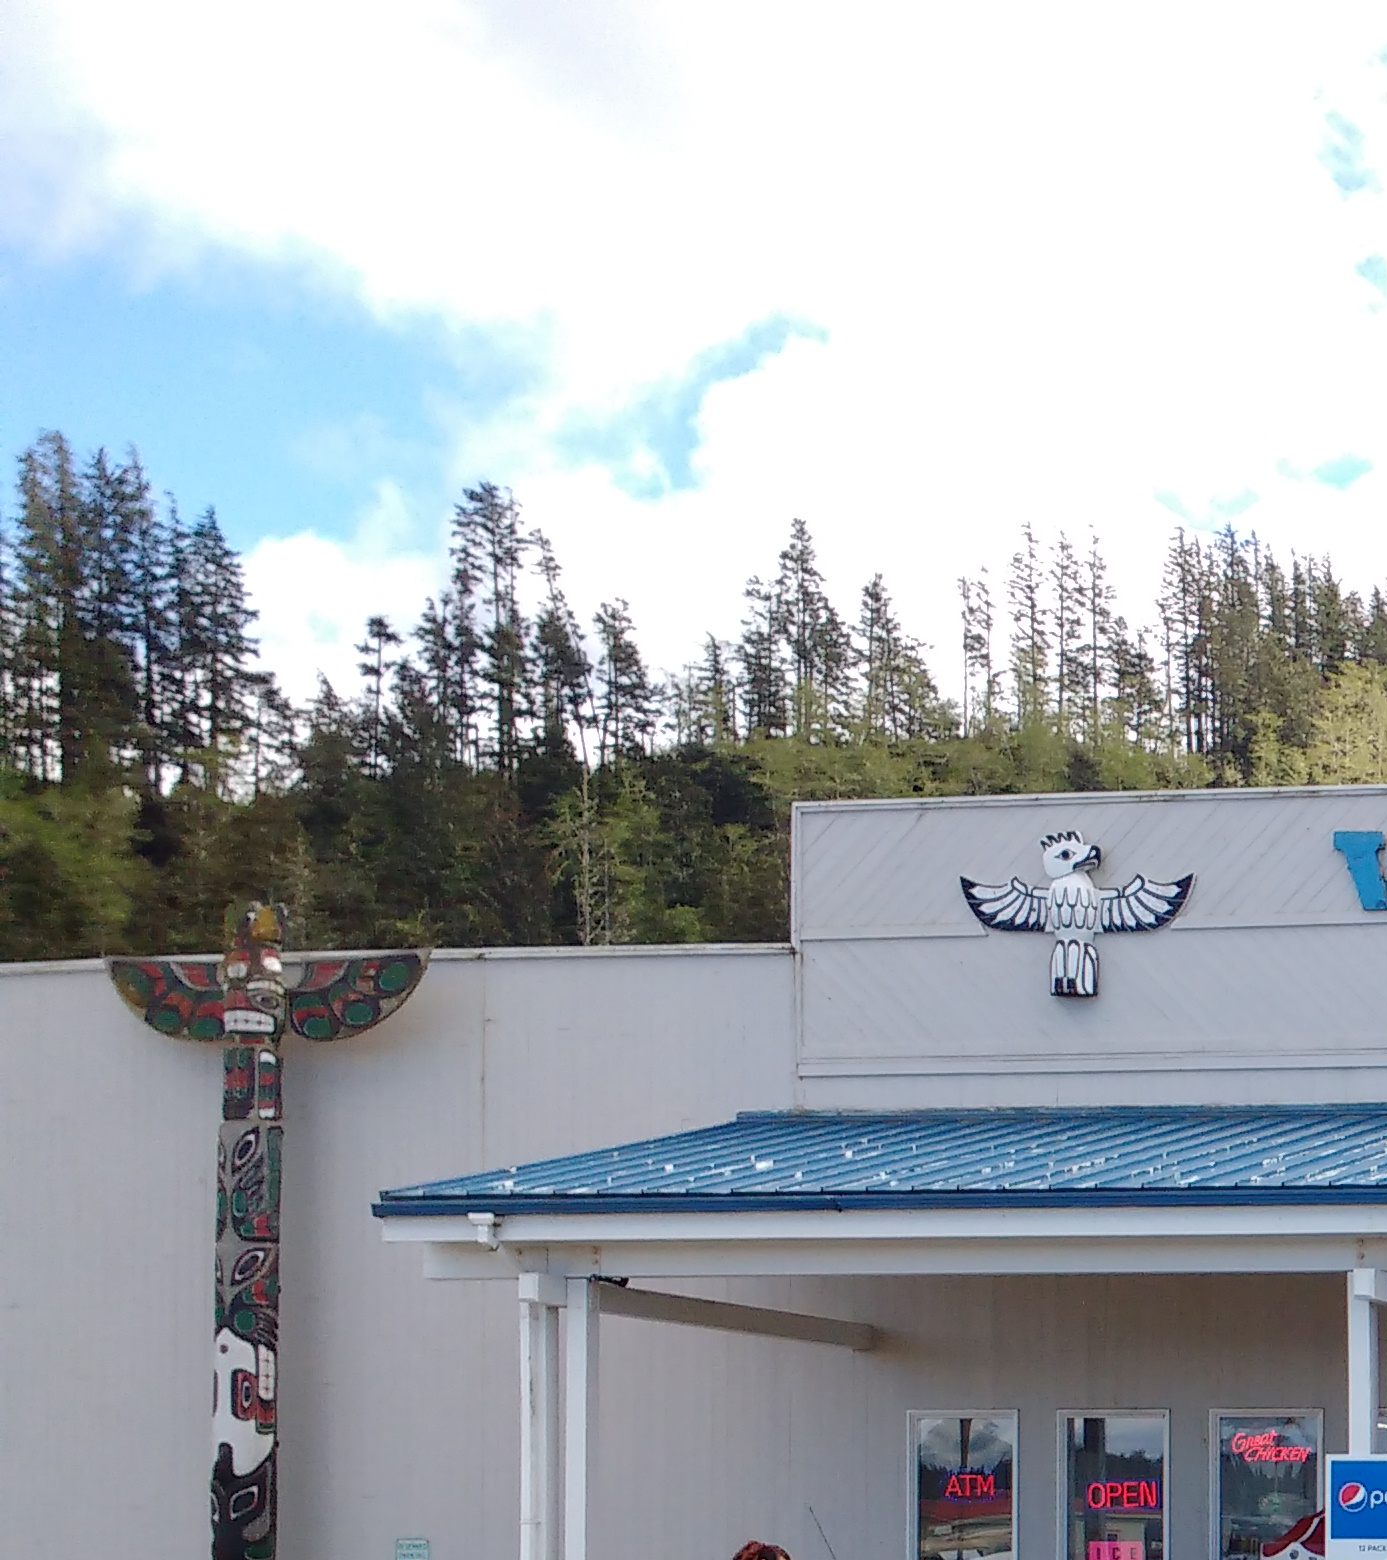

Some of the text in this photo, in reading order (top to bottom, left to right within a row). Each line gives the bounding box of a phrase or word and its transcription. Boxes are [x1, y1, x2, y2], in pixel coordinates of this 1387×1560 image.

[1244, 1447, 1312, 1463] CHICKEN
[945, 1474, 996, 1497] ATM
[1088, 1481, 1158, 1510] OPEN
[1096, 1546, 1138, 1560] ICE
